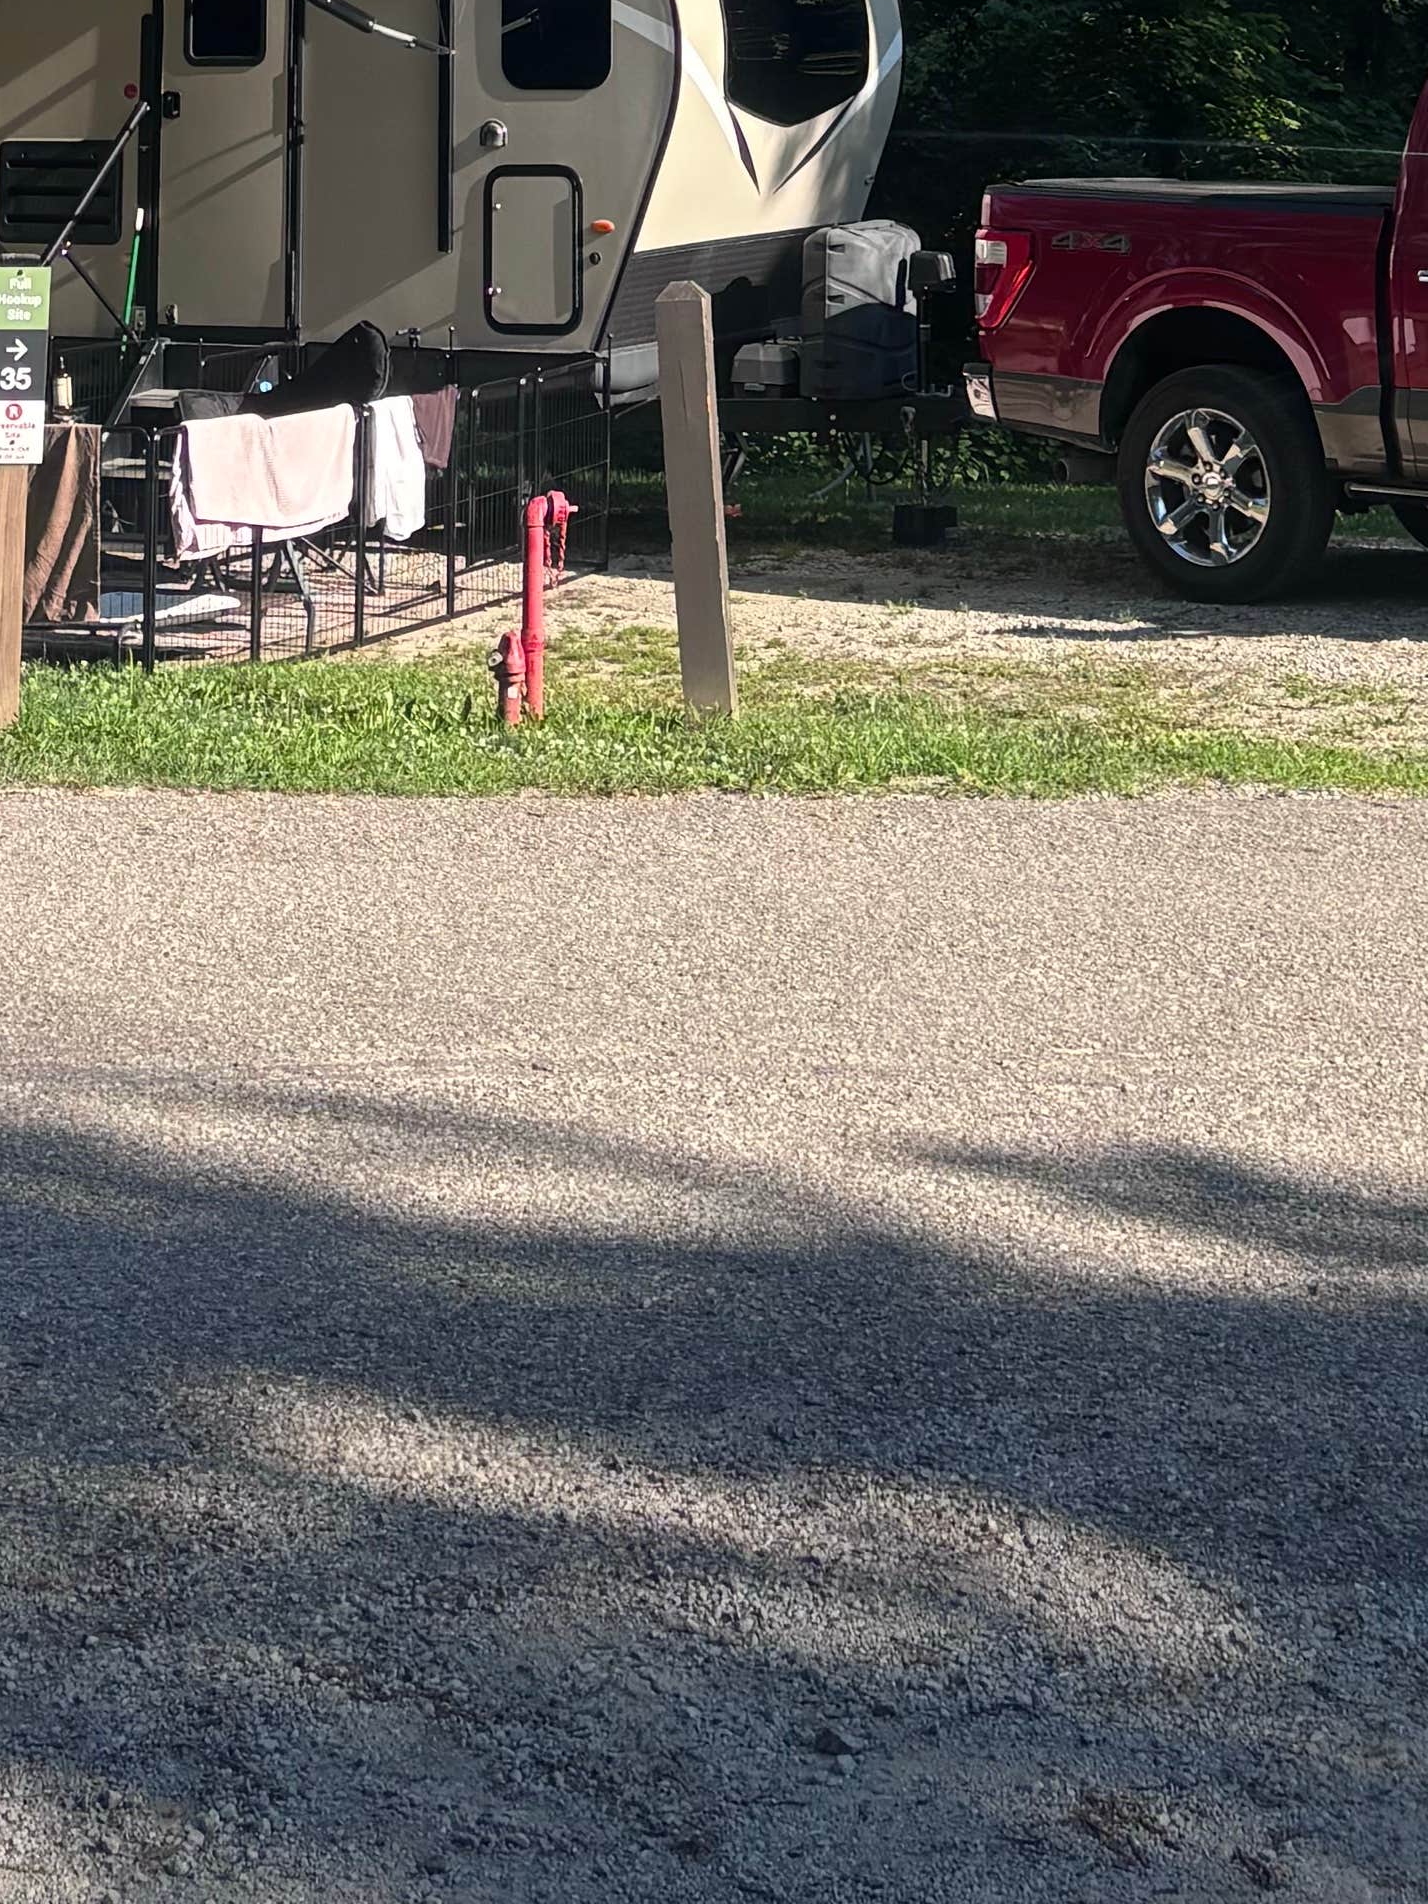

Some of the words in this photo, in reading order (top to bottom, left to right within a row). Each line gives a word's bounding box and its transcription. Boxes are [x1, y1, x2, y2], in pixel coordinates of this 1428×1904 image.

[9, 277, 32, 290] Full
[7, 308, 32, 321] Site
[0, 366, 32, 391] 35
